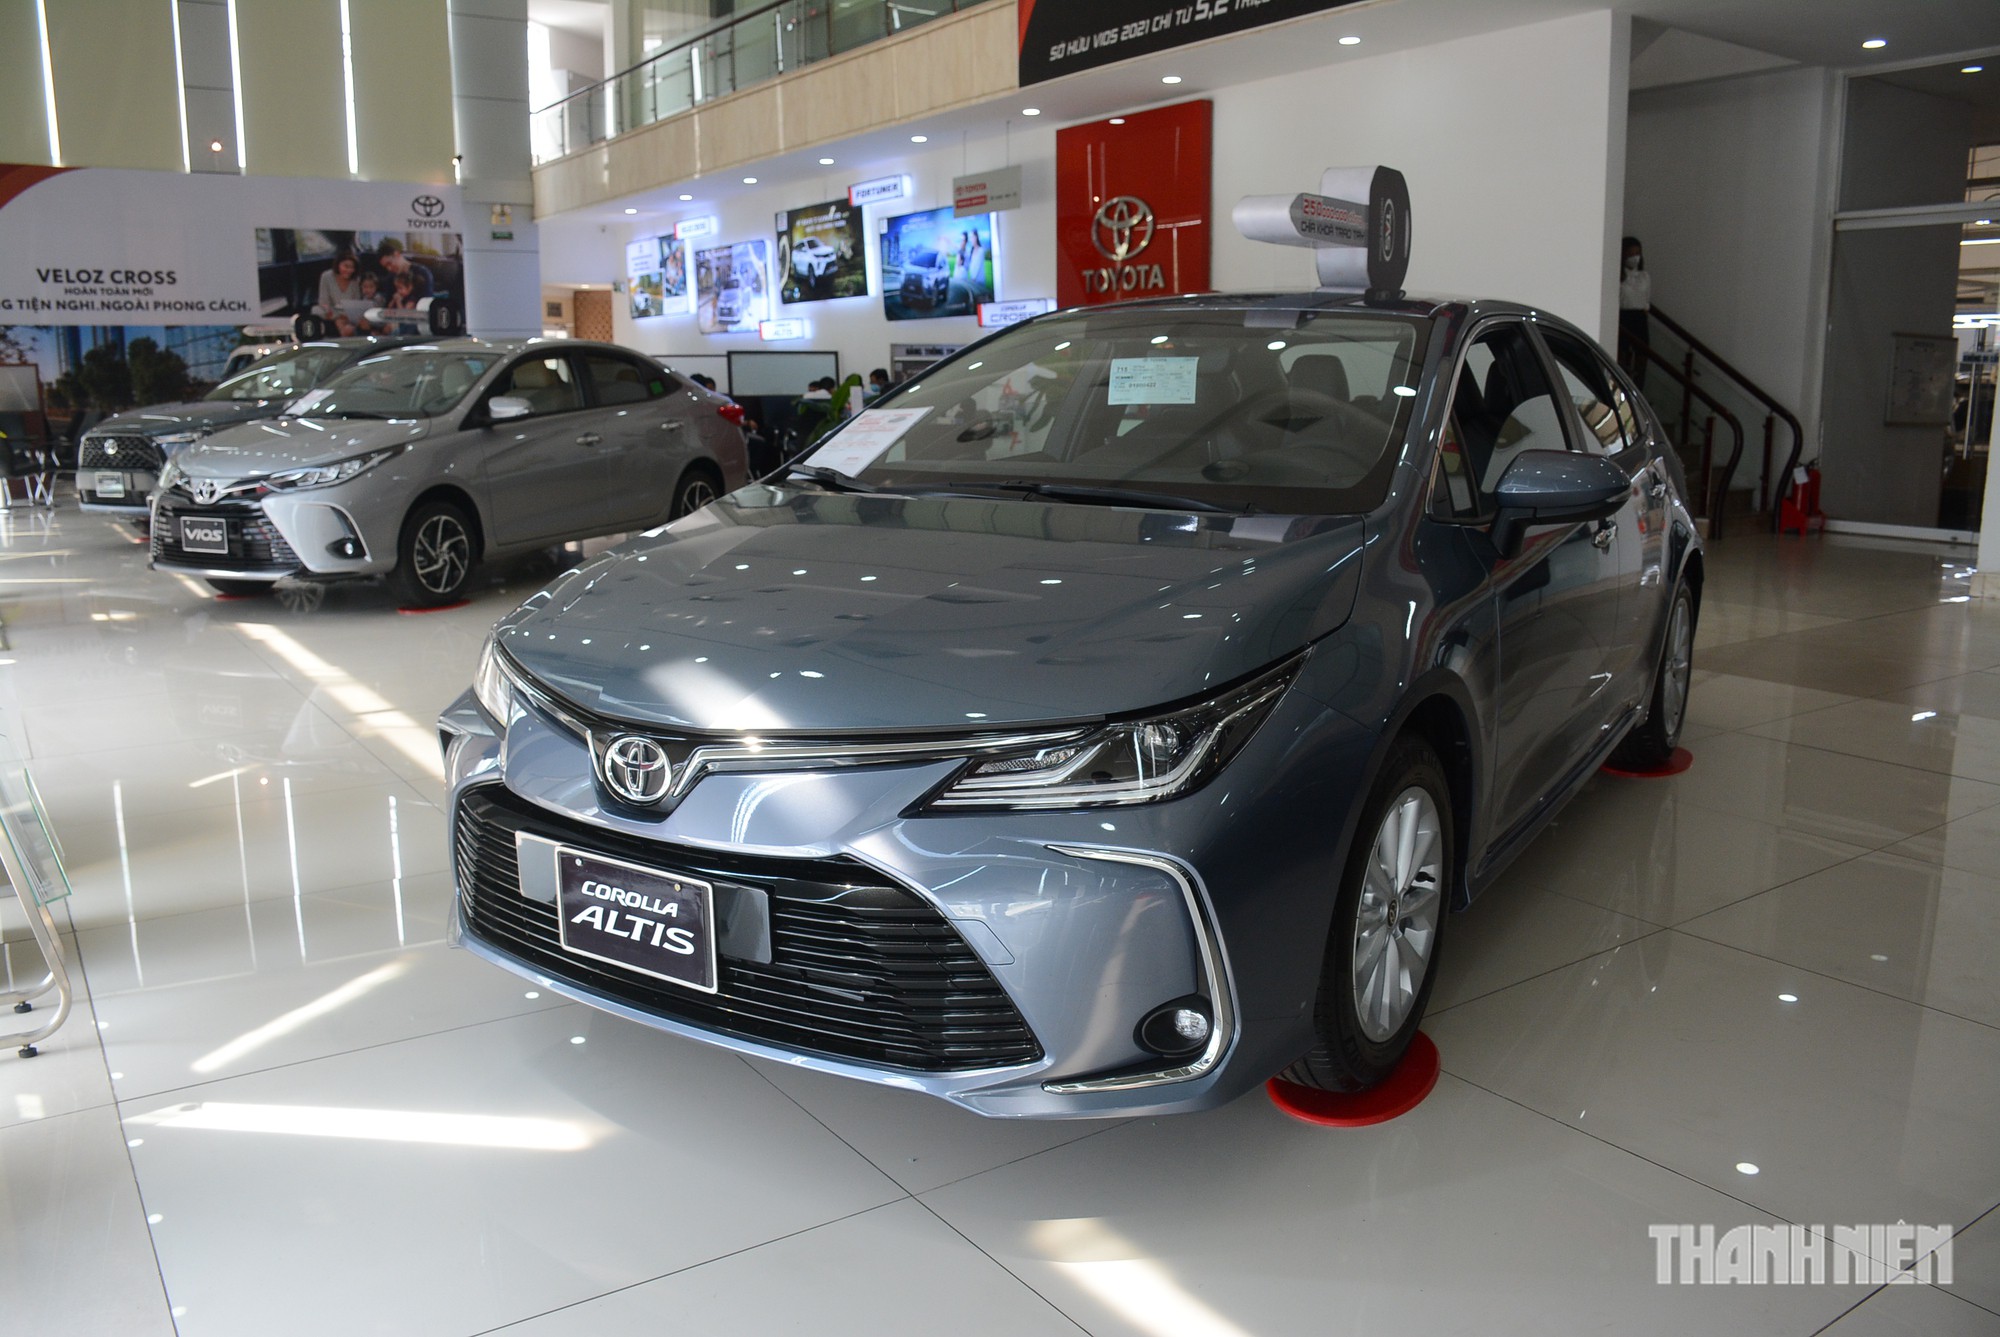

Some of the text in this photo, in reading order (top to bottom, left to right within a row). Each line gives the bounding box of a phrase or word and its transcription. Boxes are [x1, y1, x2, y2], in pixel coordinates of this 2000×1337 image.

[1093, 27, 1119, 49] VIOS
[1120, 19, 1150, 41] 2021
[1194, 0, 1229, 20] 5,2
[408, 219, 451, 229] TOYOTA
[37, 268, 177, 285] VELOZ CROSS
[1082, 263, 1165, 293] TOYOTA
[18, 296, 51, 313] TIỆN
[154, 301, 205, 312] PHONG
[184, 527, 223, 542] VIOS
[581, 880, 679, 918] COROLLA
[571, 905, 695, 955] ALTIS
